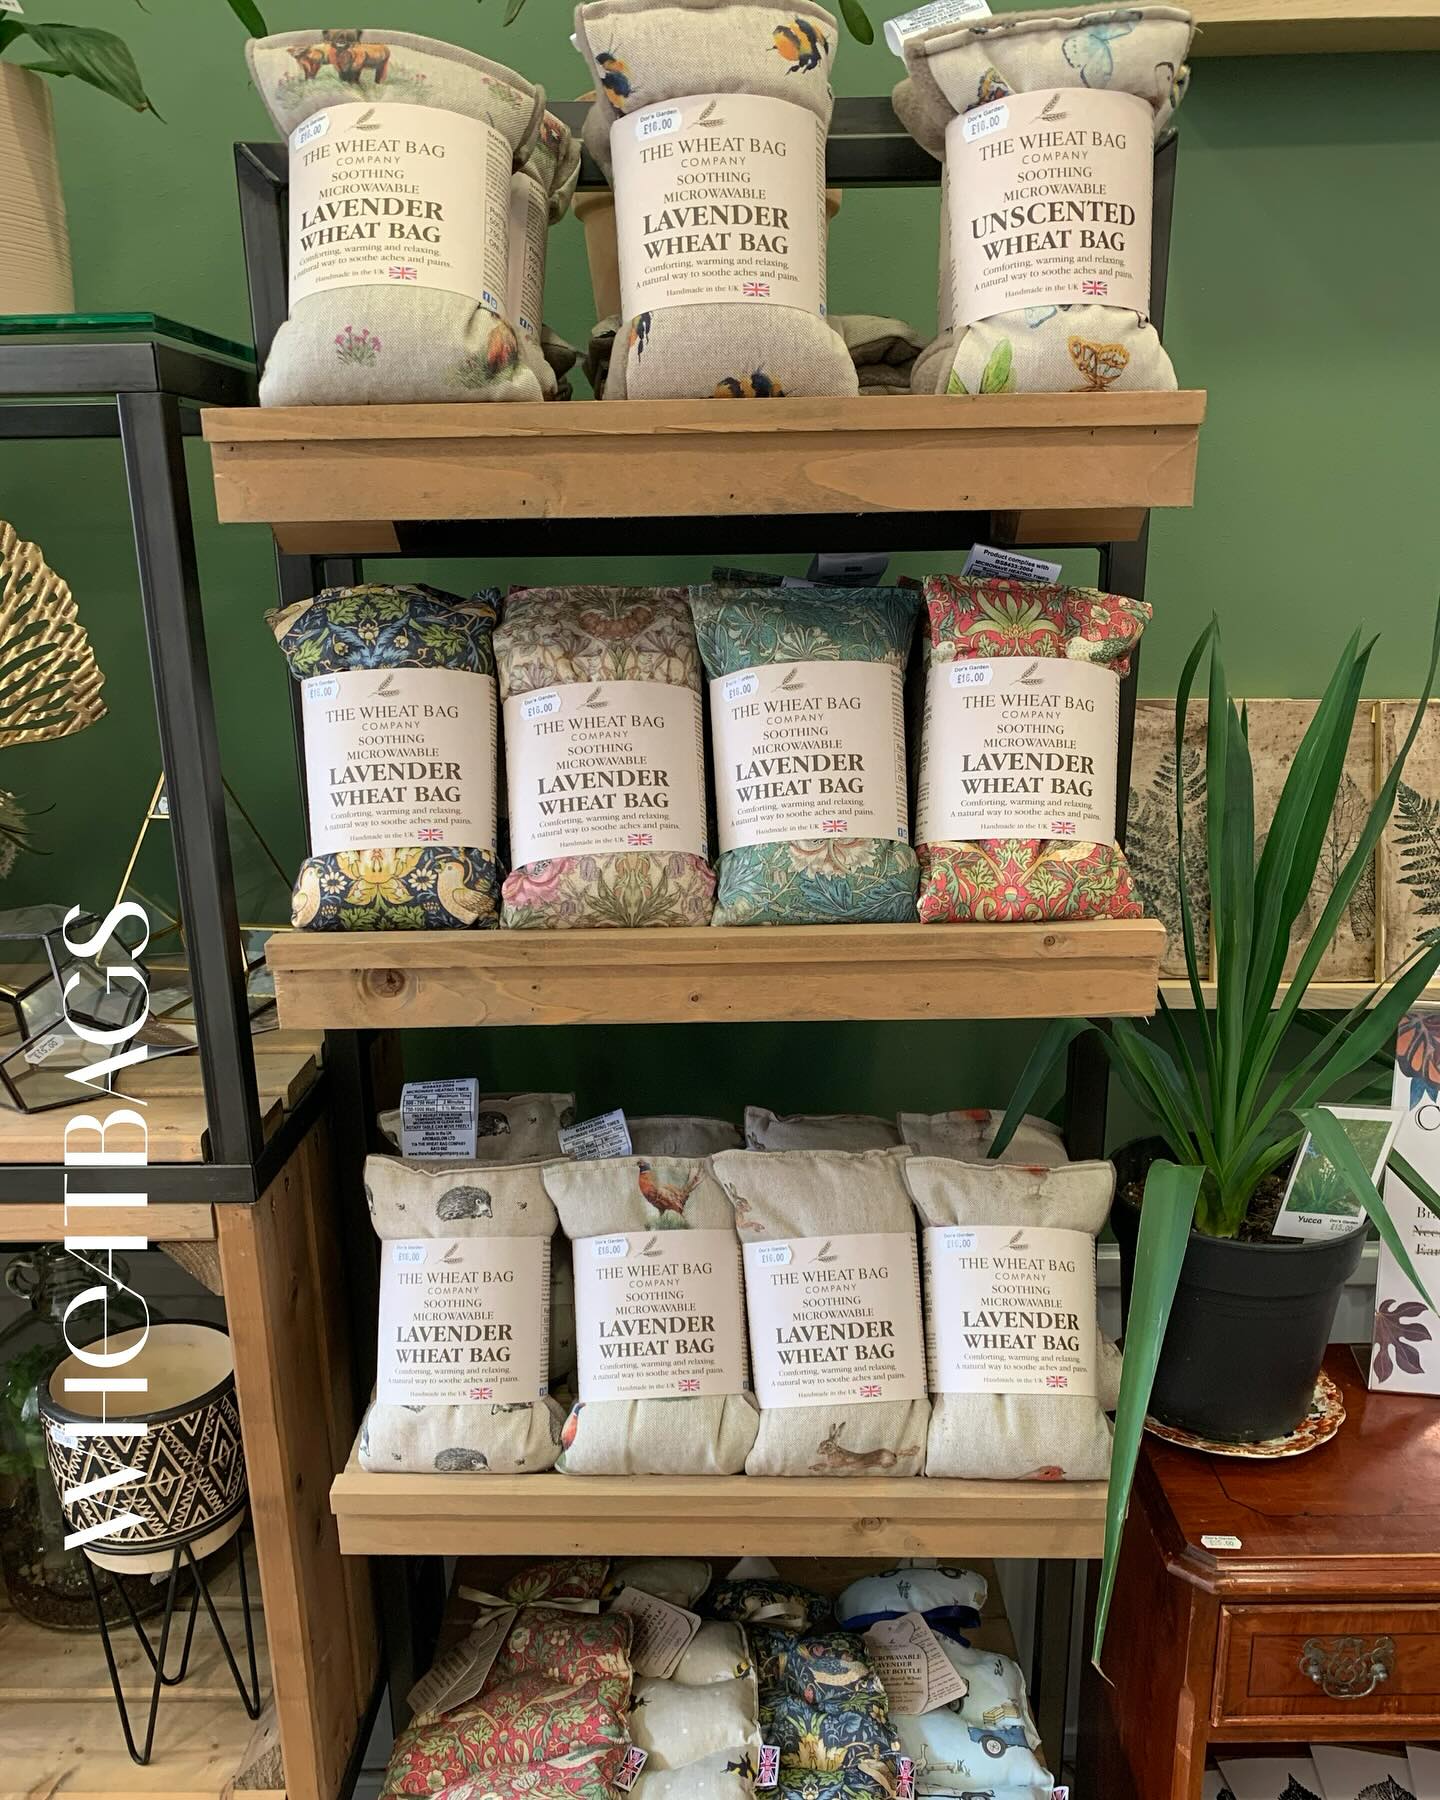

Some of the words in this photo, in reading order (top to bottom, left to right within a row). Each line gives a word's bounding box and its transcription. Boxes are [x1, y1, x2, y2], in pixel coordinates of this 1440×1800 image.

[656, 109, 677, 118] Garden
[983, 104, 1005, 117] Garden
[303, 146, 330, 166] THE
[334, 140, 400, 153] WHEAT
[406, 142, 445, 158] BAG
[640, 143, 673, 163] THE
[678, 138, 744, 153] WHEAT
[750, 138, 787, 156] BAG
[979, 139, 1014, 161] THE
[1019, 131, 1087, 149] WHEAT
[1093, 132, 1126, 149] BAG
[336, 156, 400, 166] COMPANY
[681, 156, 746, 168] COMPANY
[1022, 151, 1088, 164] COMPANY
[332, 170, 404, 182] SOOTHING
[677, 172, 750, 185] SOOTHING
[1017, 167, 1092, 183] SOOTHING
[319, 184, 420, 198] MICROWAVABLE
[664, 189, 766, 204] MICROWAVABLE
[1003, 184, 1106, 202] MICROWAVABLE
[301, 198, 444, 232] LAVENDER
[643, 205, 790, 236] LAVENDER
[971, 201, 1135, 238] UNSCENTED
[300, 222, 380, 252] WHEAT
[390, 224, 441, 242] BAG
[982, 230, 1071, 260] WHEAT
[1080, 230, 1125, 250] BAG
[644, 233, 731, 259] WHEAT
[740, 234, 788, 254] BAG
[644, 259, 694, 274] Comforting,
[696, 258, 734, 267] warming
[737, 257, 753, 265] and
[642, 274, 669, 287] natural
[672, 272, 688, 282] way
[702, 269, 731, 277] soothe
[760, 269, 775, 277] and
[666, 287, 703, 296] Handmade
[984, 549, 1007, 559] Product
[1008, 557, 1035, 567] complies
[975, 559, 1007, 572] MICROWAVE
[1009, 569, 1032, 577] HEATING
[732, 703, 760, 720] THE
[764, 697, 823, 712] WHEAT
[827, 697, 861, 709] BAG
[963, 696, 995, 709] THE
[1000, 694, 1061, 707] WHEAT
[1065, 696, 1094, 712] BAG
[325, 708, 355, 723] THE
[360, 705, 419, 718] WHEAT
[425, 706, 458, 718] BAG
[767, 713, 824, 724] COMPANY
[1002, 711, 1061, 719] COMPANY
[362, 721, 420, 731] COMPANY
[534, 720, 564, 735] THE
[568, 715, 626, 730] WHEAT
[631, 715, 665, 728] BAG
[997, 724, 1064, 734] SOOTHING
[358, 734, 424, 746] SOOTHING
[571, 731, 628, 741] COMPANY
[763, 727, 828, 740] SOOTHING
[568, 743, 633, 755] SOOTHING
[752, 740, 842, 755] MICROWAVABLE
[984, 738, 1076, 750] MICROWAVABLE
[347, 748, 439, 760] MICROWAVABLE
[557, 756, 647, 770] MICROWAVABLE
[736, 754, 864, 781] LAVENDER
[962, 753, 1094, 775] LAVENDER
[330, 762, 462, 785] LAVENDER
[538, 770, 670, 795] LAVENDER
[736, 779, 812, 803] WHEAT
[820, 778, 863, 793] BAG
[962, 778, 1044, 794] WHEAT
[1051, 779, 1093, 796] BAG
[330, 787, 407, 807] WHEAT
[415, 786, 461, 802] BAG
[539, 794, 616, 816] WHEAT
[625, 793, 669, 808] BAG
[1298, 1216, 1322, 1224] Yucca
[596, 1267, 623, 1280] THE
[627, 1264, 679, 1277] WHEAT
[683, 1262, 712, 1274] BAG
[959, 1257, 989, 1269] THE
[993, 1258, 1045, 1269] WHEAT
[1049, 1259, 1075, 1272] BAG
[398, 1273, 422, 1284] THE
[427, 1272, 479, 1283] WHEAT
[483, 1271, 514, 1282] BAG
[629, 1279, 680, 1288] COMPANY
[770, 1273, 799, 1285] THE
[803, 1269, 854, 1282] WHEAT
[859, 1267, 888, 1279] BAG
[995, 1273, 1046, 1281] COMPANY
[626, 1291, 684, 1302] SOOTHING
[806, 1284, 857, 1294] COMPANY
[992, 1285, 1050, 1295] SOOTHING
[424, 1298, 482, 1308] SOOTHING
[616, 1303, 696, 1315] MICROWAVABLE
[803, 1296, 861, 1307] SOOTHING
[981, 1298, 1062, 1308] MICROWAVABLE
[413, 1312, 493, 1321] MICROWAVABLE
[793, 1308, 874, 1321] MICROWAVABLE
[962, 1311, 1080, 1330] LAVENDER
[397, 1325, 512, 1343] LAVENDER
[599, 1316, 715, 1338] LAVENDER
[776, 1321, 895, 1344] LAVENDER
[600, 1339, 669, 1358] WHEAT
[677, 1338, 714, 1354] BAG
[963, 1335, 1036, 1350] WHEAT
[1043, 1336, 1079, 1351] BAG
[396, 1348, 463, 1363] WHEAT
[470, 1347, 510, 1362] BAG
[777, 1347, 849, 1364] WHEAT
[856, 1344, 894, 1359] BAG
